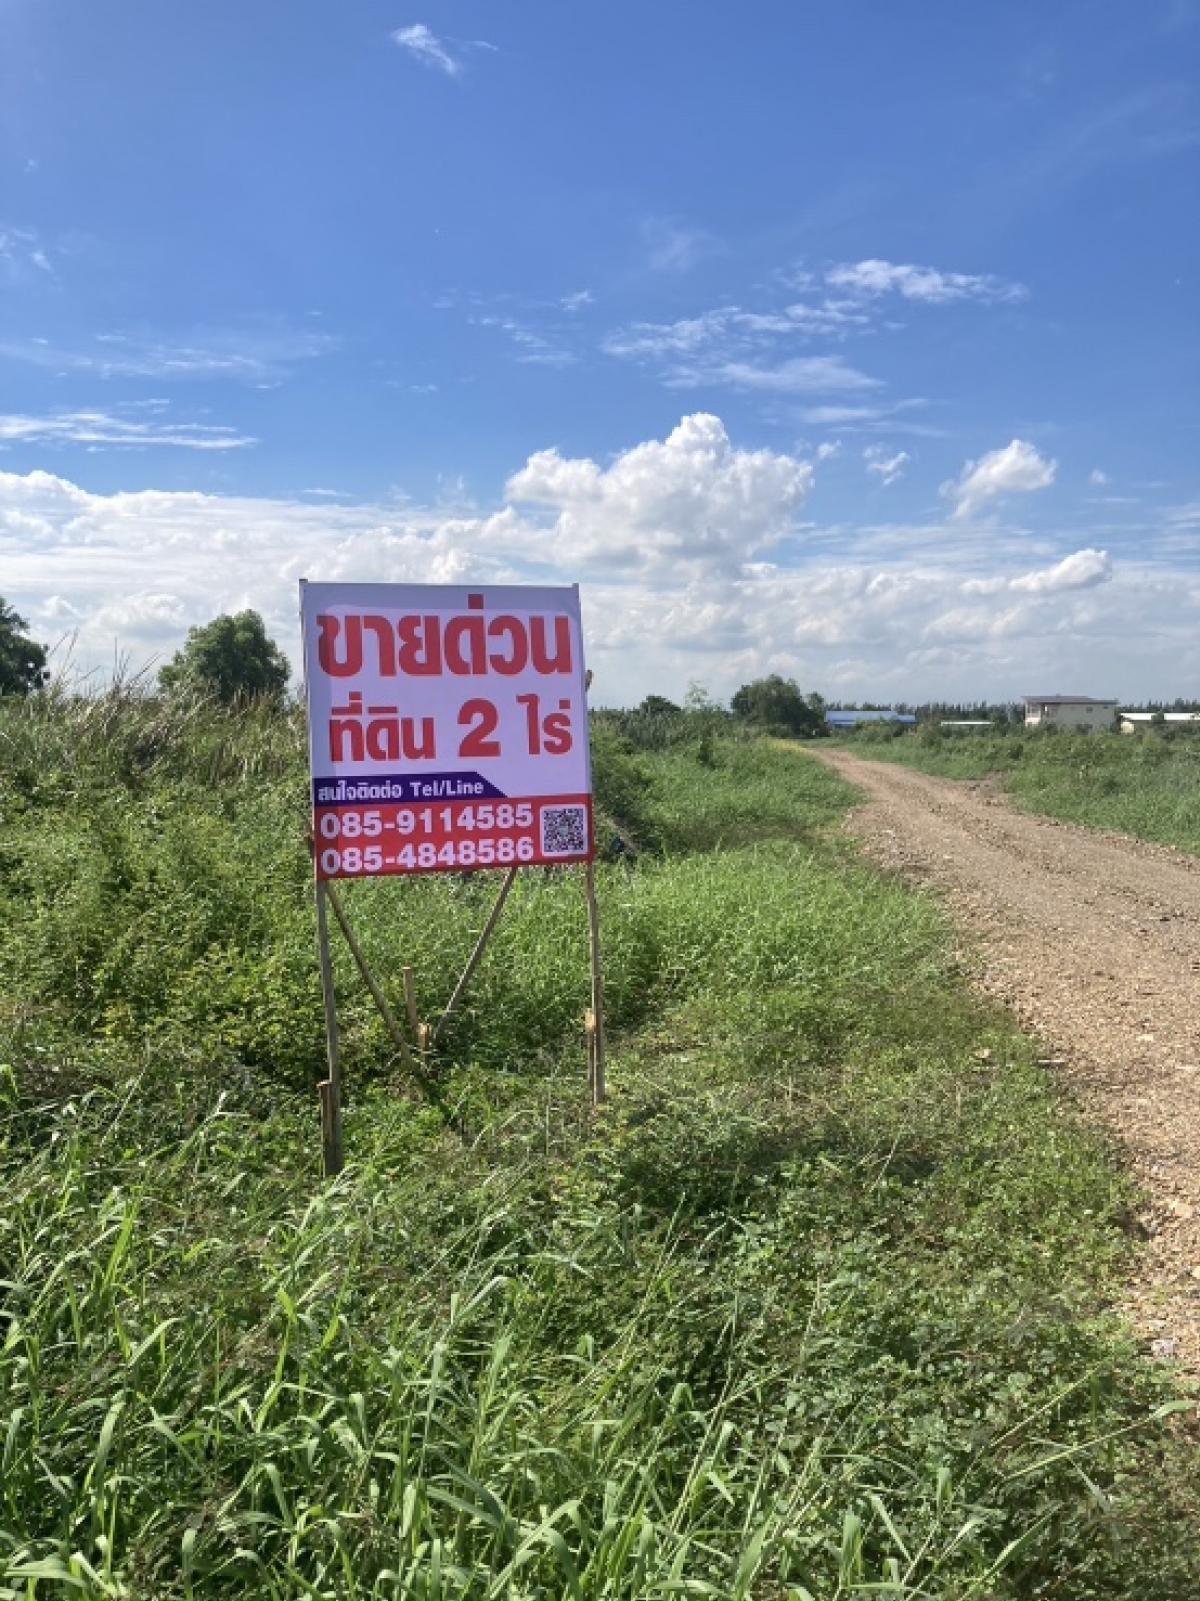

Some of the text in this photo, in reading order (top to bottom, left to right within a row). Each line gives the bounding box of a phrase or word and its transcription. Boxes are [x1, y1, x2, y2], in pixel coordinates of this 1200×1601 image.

[316, 593, 573, 677] ขายด่วน
[329, 691, 573, 762] ที่ดิน 2 ไร่
[317, 780, 485, 802] สนใจติดต่อ Tel/Line
[320, 803, 534, 840] 085-9114585
[320, 836, 534, 874] 085-4848586
